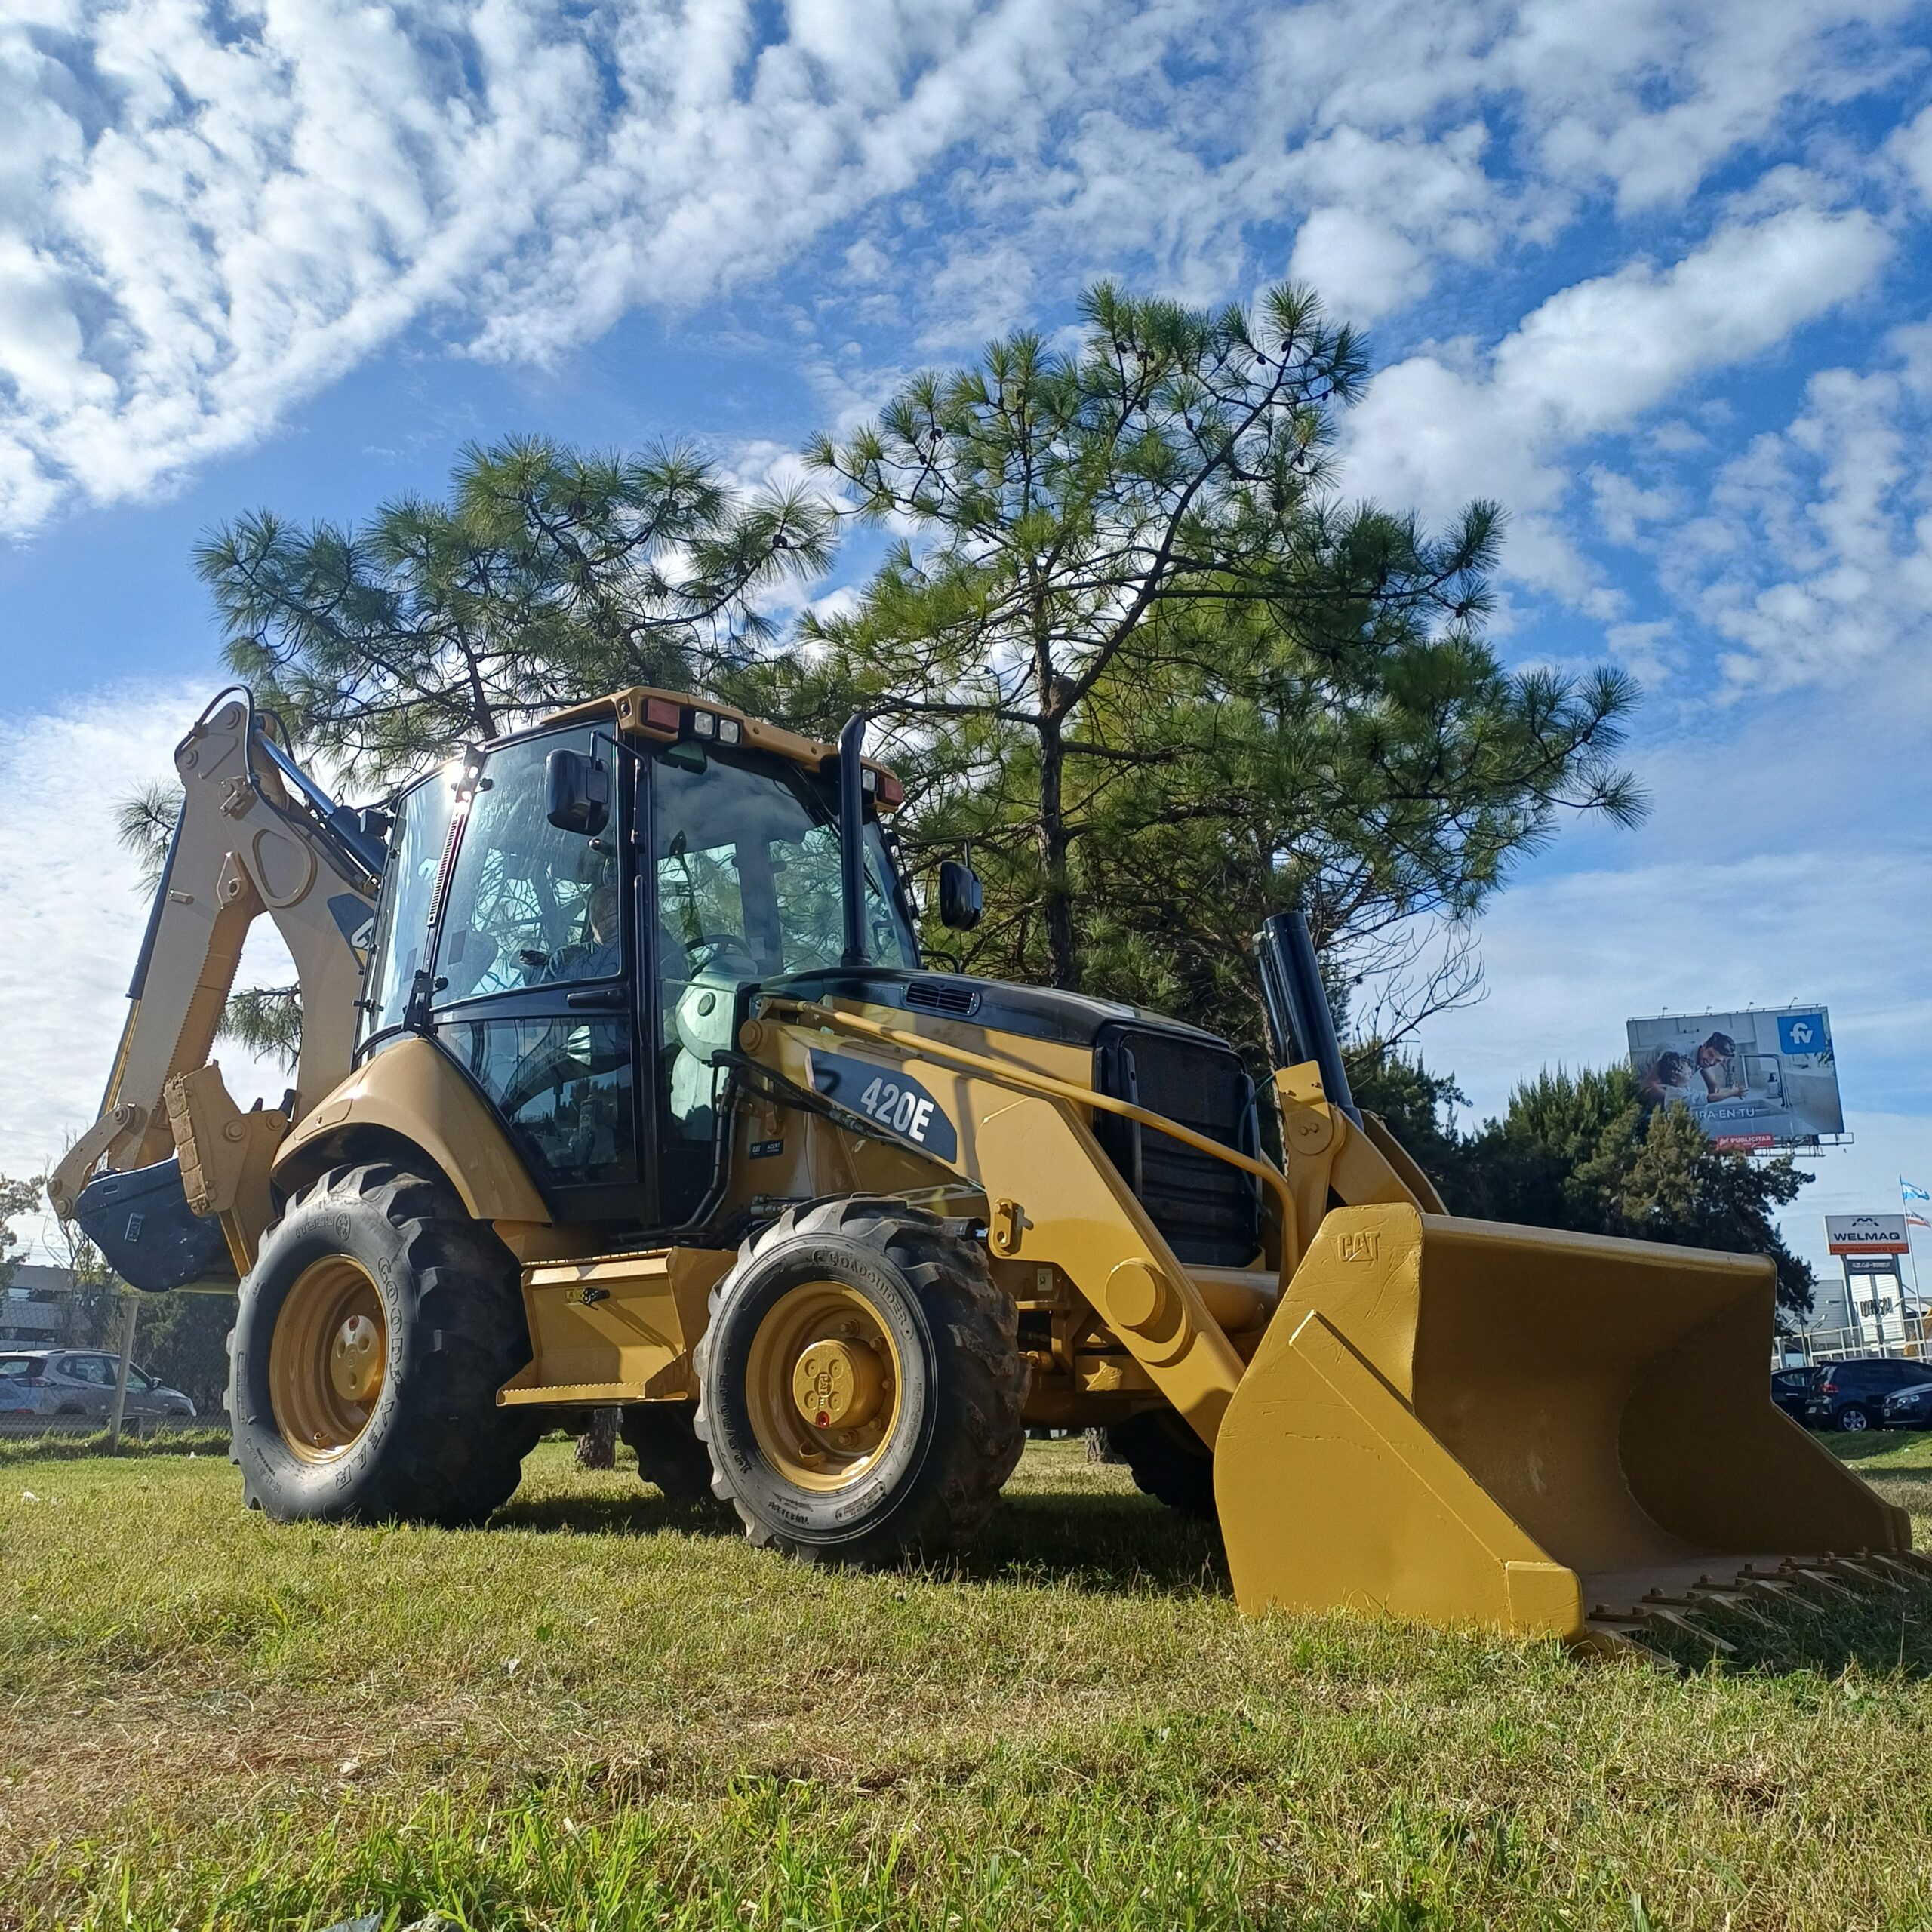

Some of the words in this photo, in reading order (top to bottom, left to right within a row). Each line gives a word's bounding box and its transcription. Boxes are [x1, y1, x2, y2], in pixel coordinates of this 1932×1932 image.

[860, 1077, 935, 1143] 420E
[1718, 1109, 1737, 1119] EN
[1738, 1107, 1756, 1118] TU
[1730, 1134, 1772, 1143] PUBLICITAR
[1833, 1232, 1901, 1241] WELMAQ
[1337, 1231, 1381, 1263] CAT
